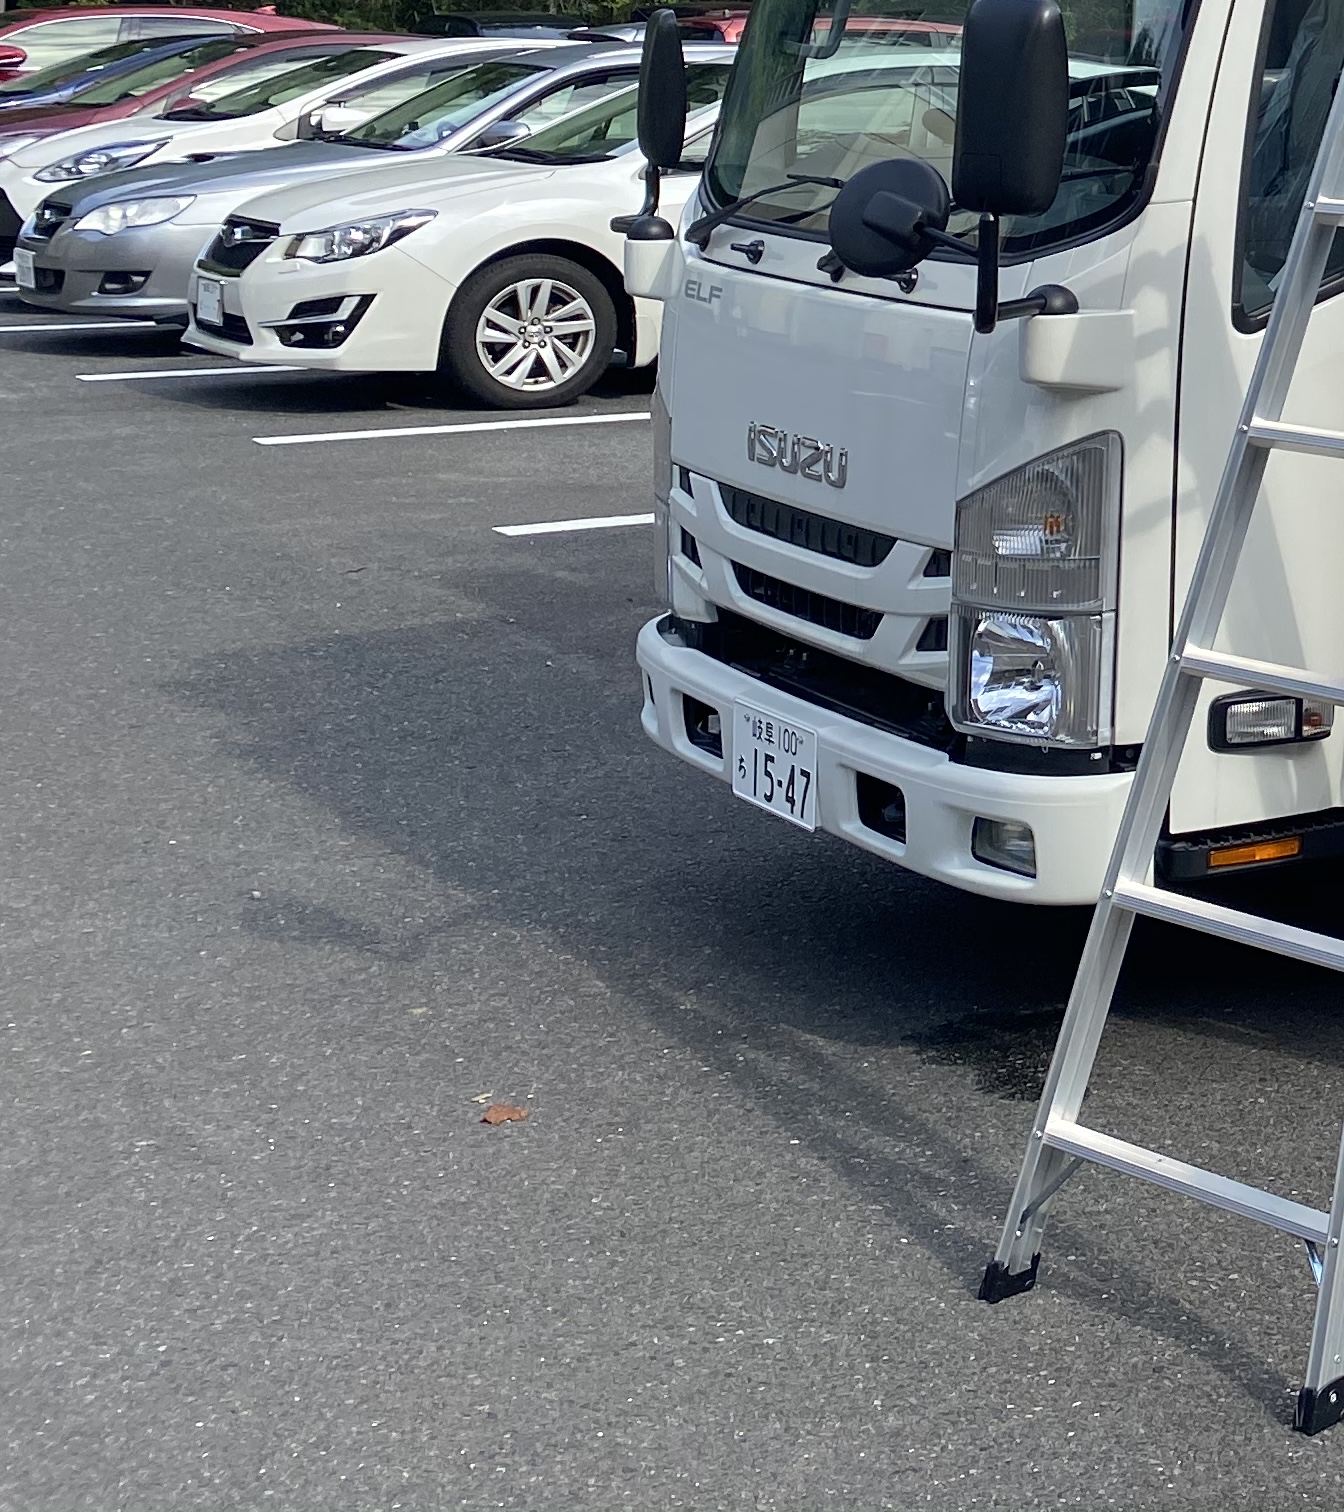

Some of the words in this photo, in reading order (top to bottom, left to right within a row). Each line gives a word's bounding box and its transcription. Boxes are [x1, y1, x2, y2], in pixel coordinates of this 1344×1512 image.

[685, 279, 723, 304] ELF
[748, 421, 847, 488] ISUZU
[753, 747, 811, 819] 15-47
